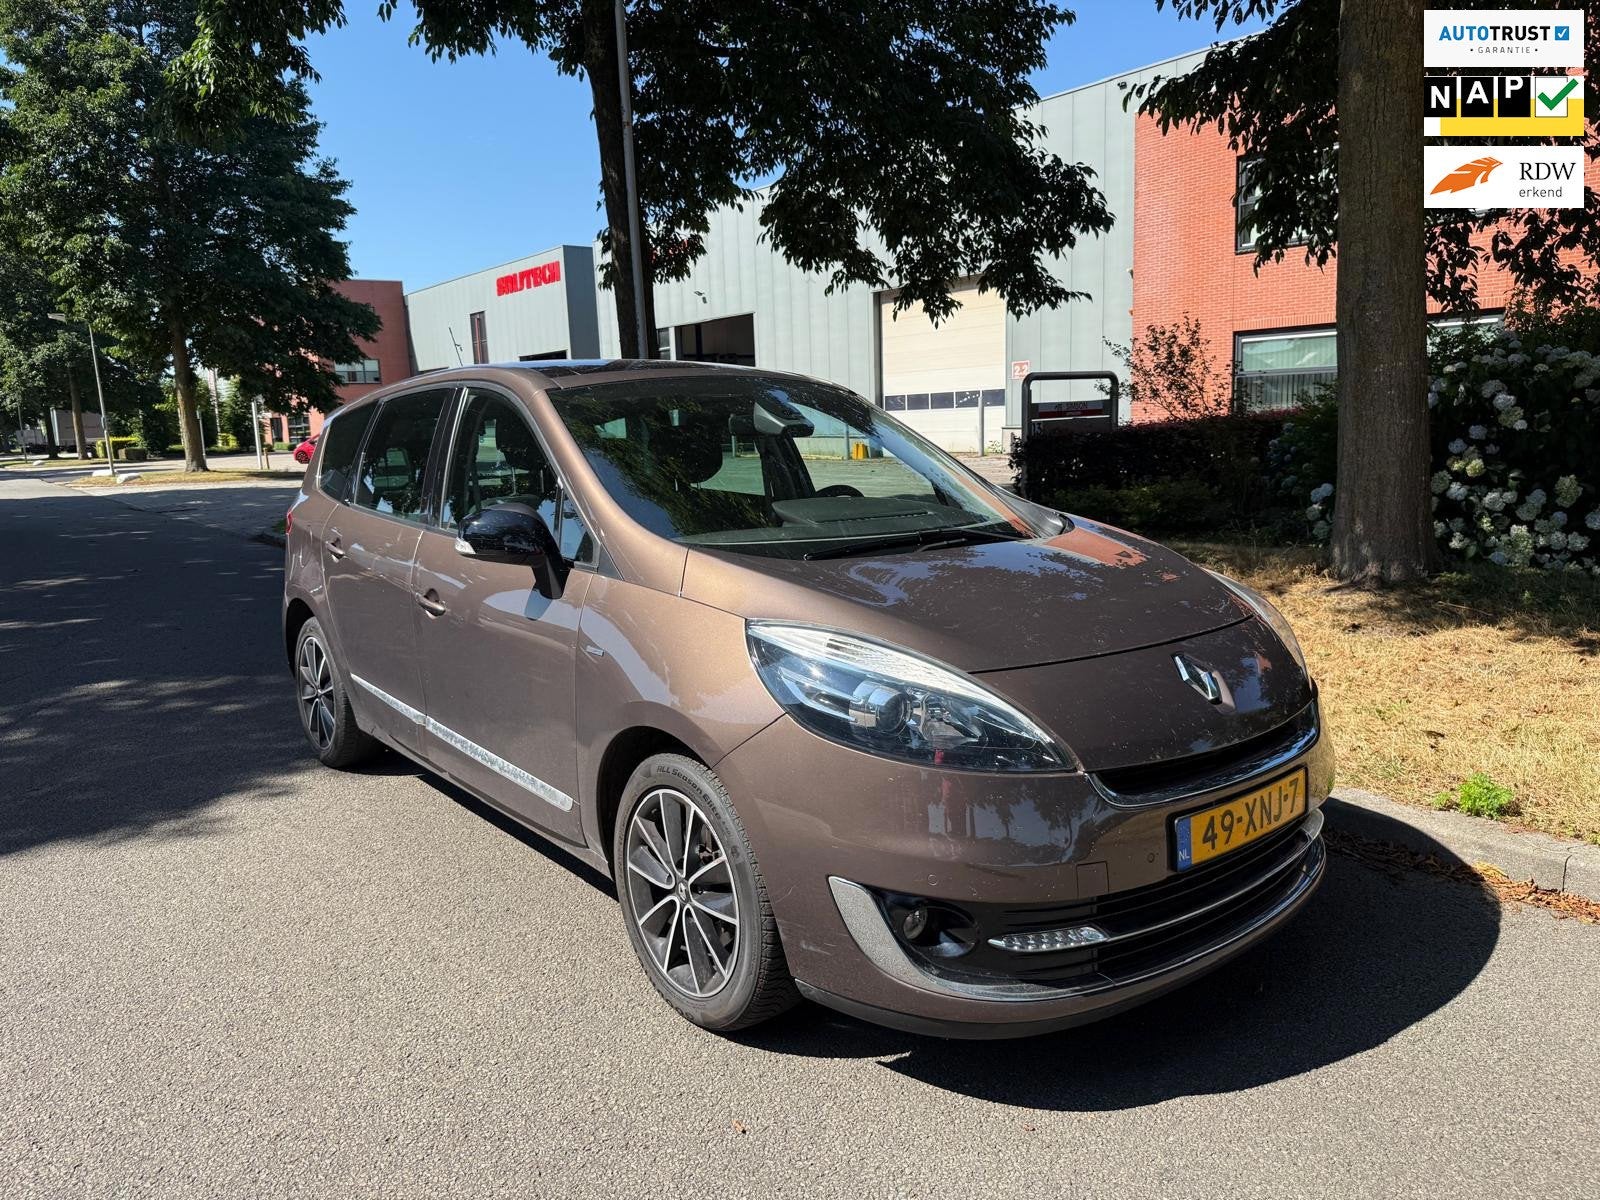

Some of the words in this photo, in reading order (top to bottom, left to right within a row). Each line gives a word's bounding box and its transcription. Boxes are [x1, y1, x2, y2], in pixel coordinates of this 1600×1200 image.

[671, 768, 703, 795] Season
[1202, 776, 1299, 850] 49-XNJ-7
[1178, 850, 1190, 862] NL
